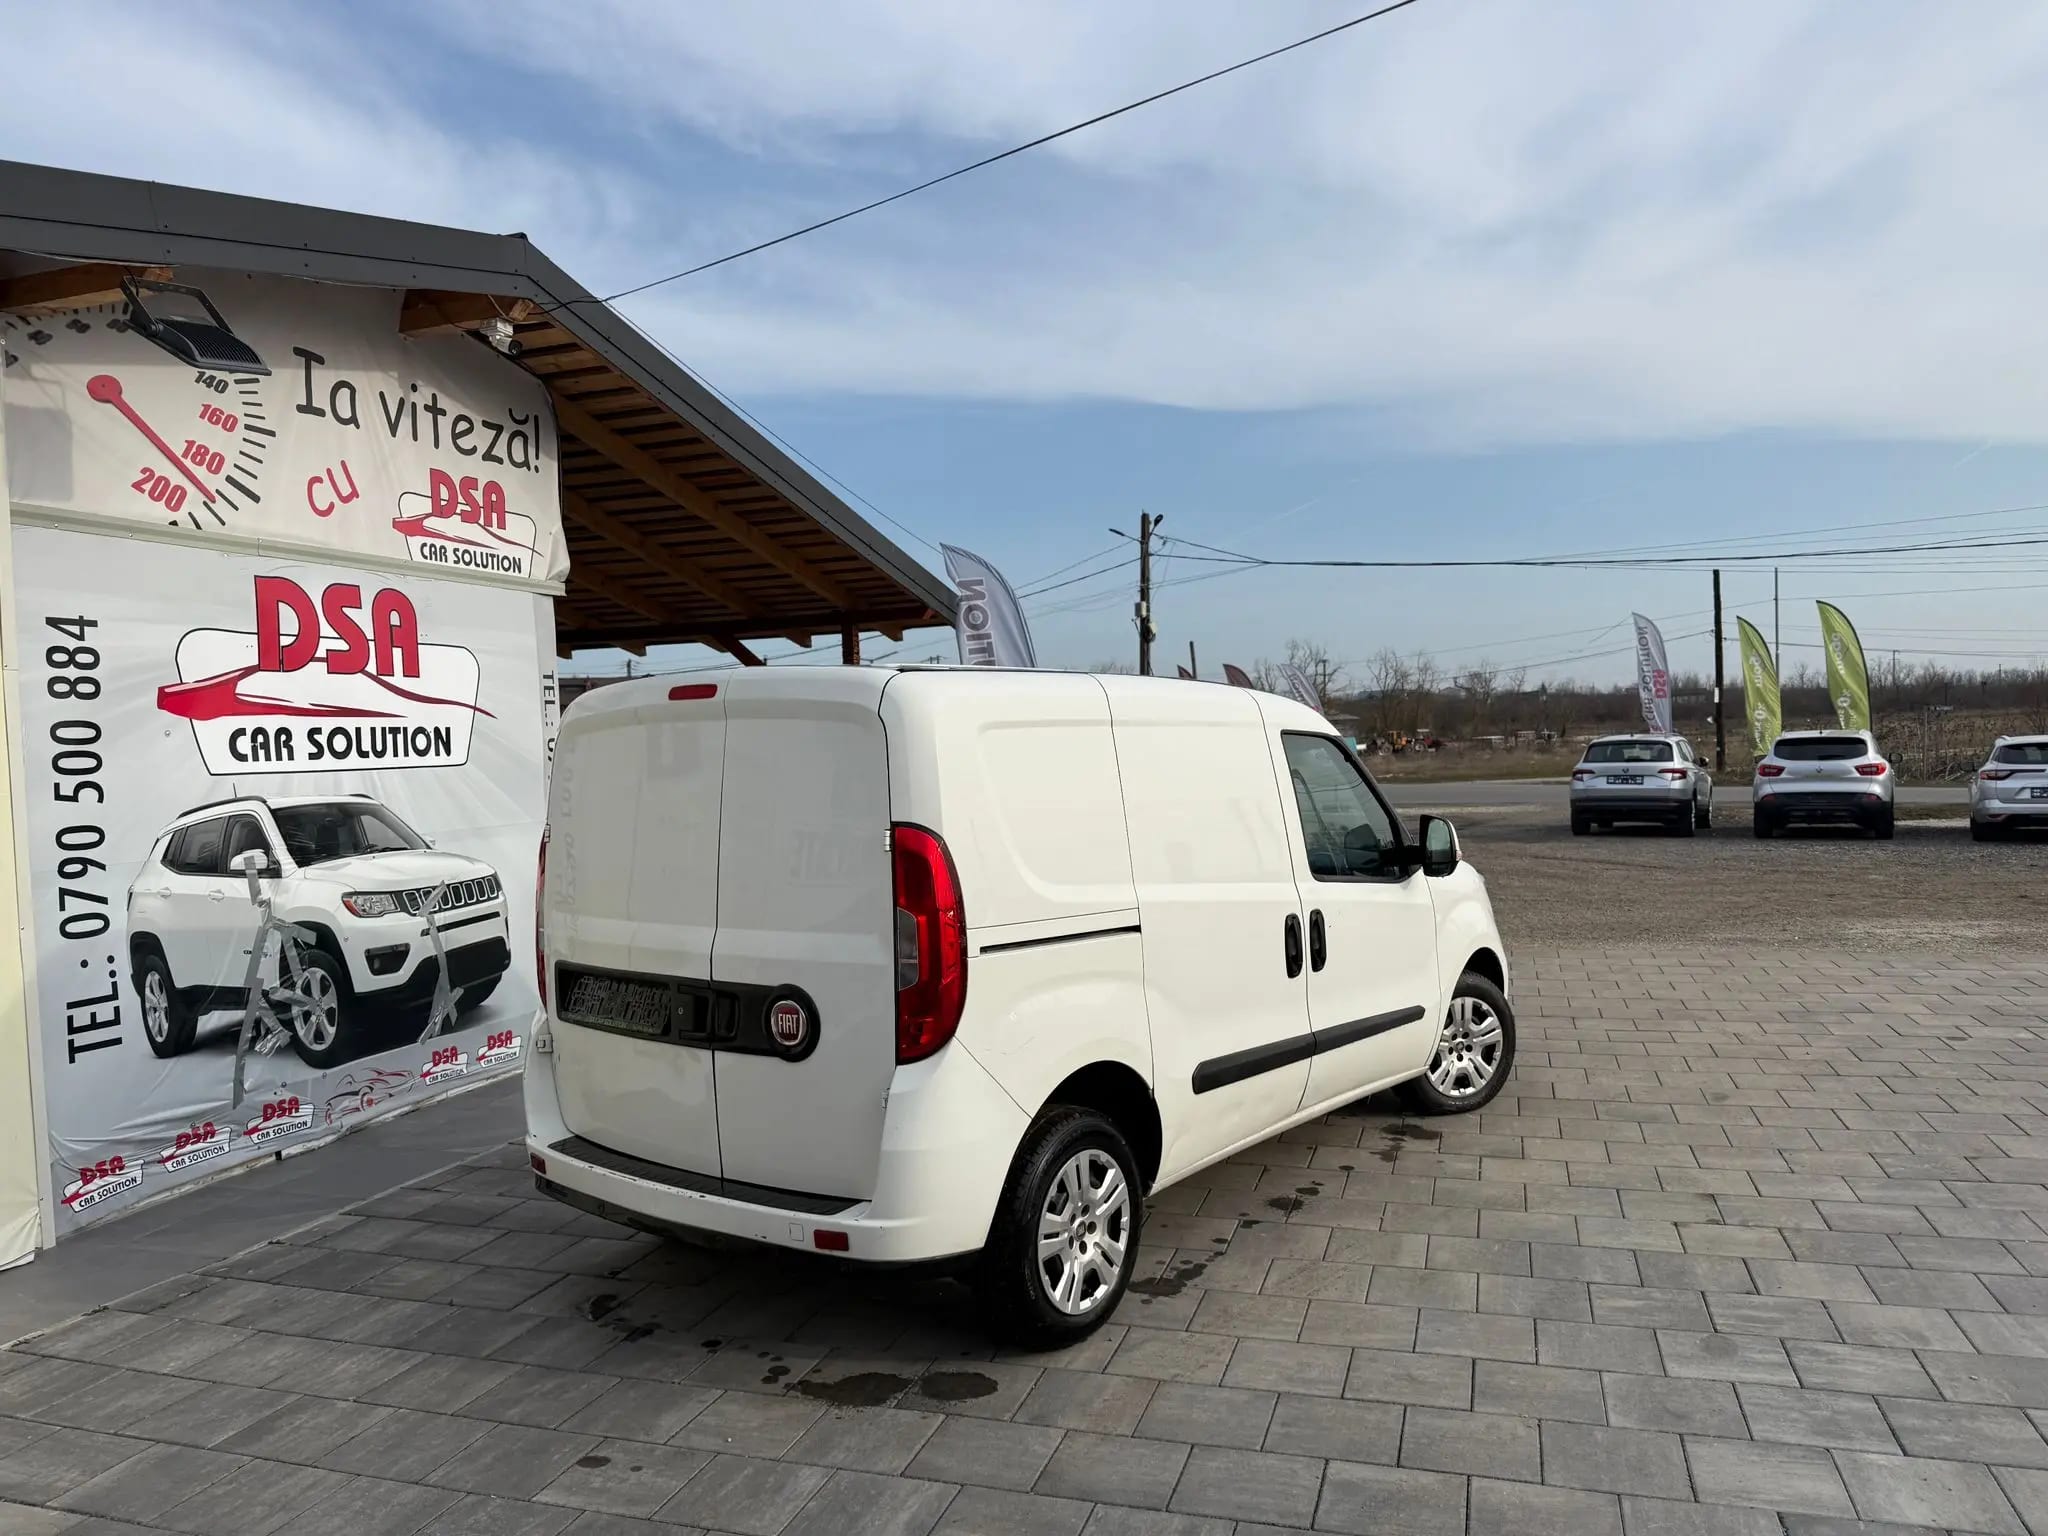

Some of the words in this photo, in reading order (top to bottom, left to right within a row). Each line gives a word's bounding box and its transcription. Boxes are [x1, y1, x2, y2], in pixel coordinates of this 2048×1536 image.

[194, 371, 229, 394] 140
[199, 403, 238, 432] 160
[293, 346, 360, 430] Ia
[378, 383, 540, 474] viteză!
[181, 440, 225, 475] 180
[131, 467, 187, 512] 200
[307, 460, 359, 517] cu
[430, 468, 506, 530] DSA
[420, 542, 448, 563] CAR
[453, 548, 522, 574] SOLUTION
[254, 575, 420, 678] DSA
[45, 615, 101, 701] 884
[49, 719, 104, 804] 500
[229, 726, 294, 762] CAR
[307, 726, 451, 761] SOLUTION
[55, 824, 111, 940] 0790
[66, 955, 122, 1064] TEL.:
[778, 1013, 798, 1034] FIAT
[262, 1097, 301, 1122] DSA
[176, 1121, 216, 1150] DSA
[256, 1130, 271, 1141] CAR
[272, 1120, 308, 1137] SOLUTION
[80, 1156, 125, 1186] DSA
[171, 1157, 187, 1169] CAR
[188, 1145, 226, 1163] SOLUTION
